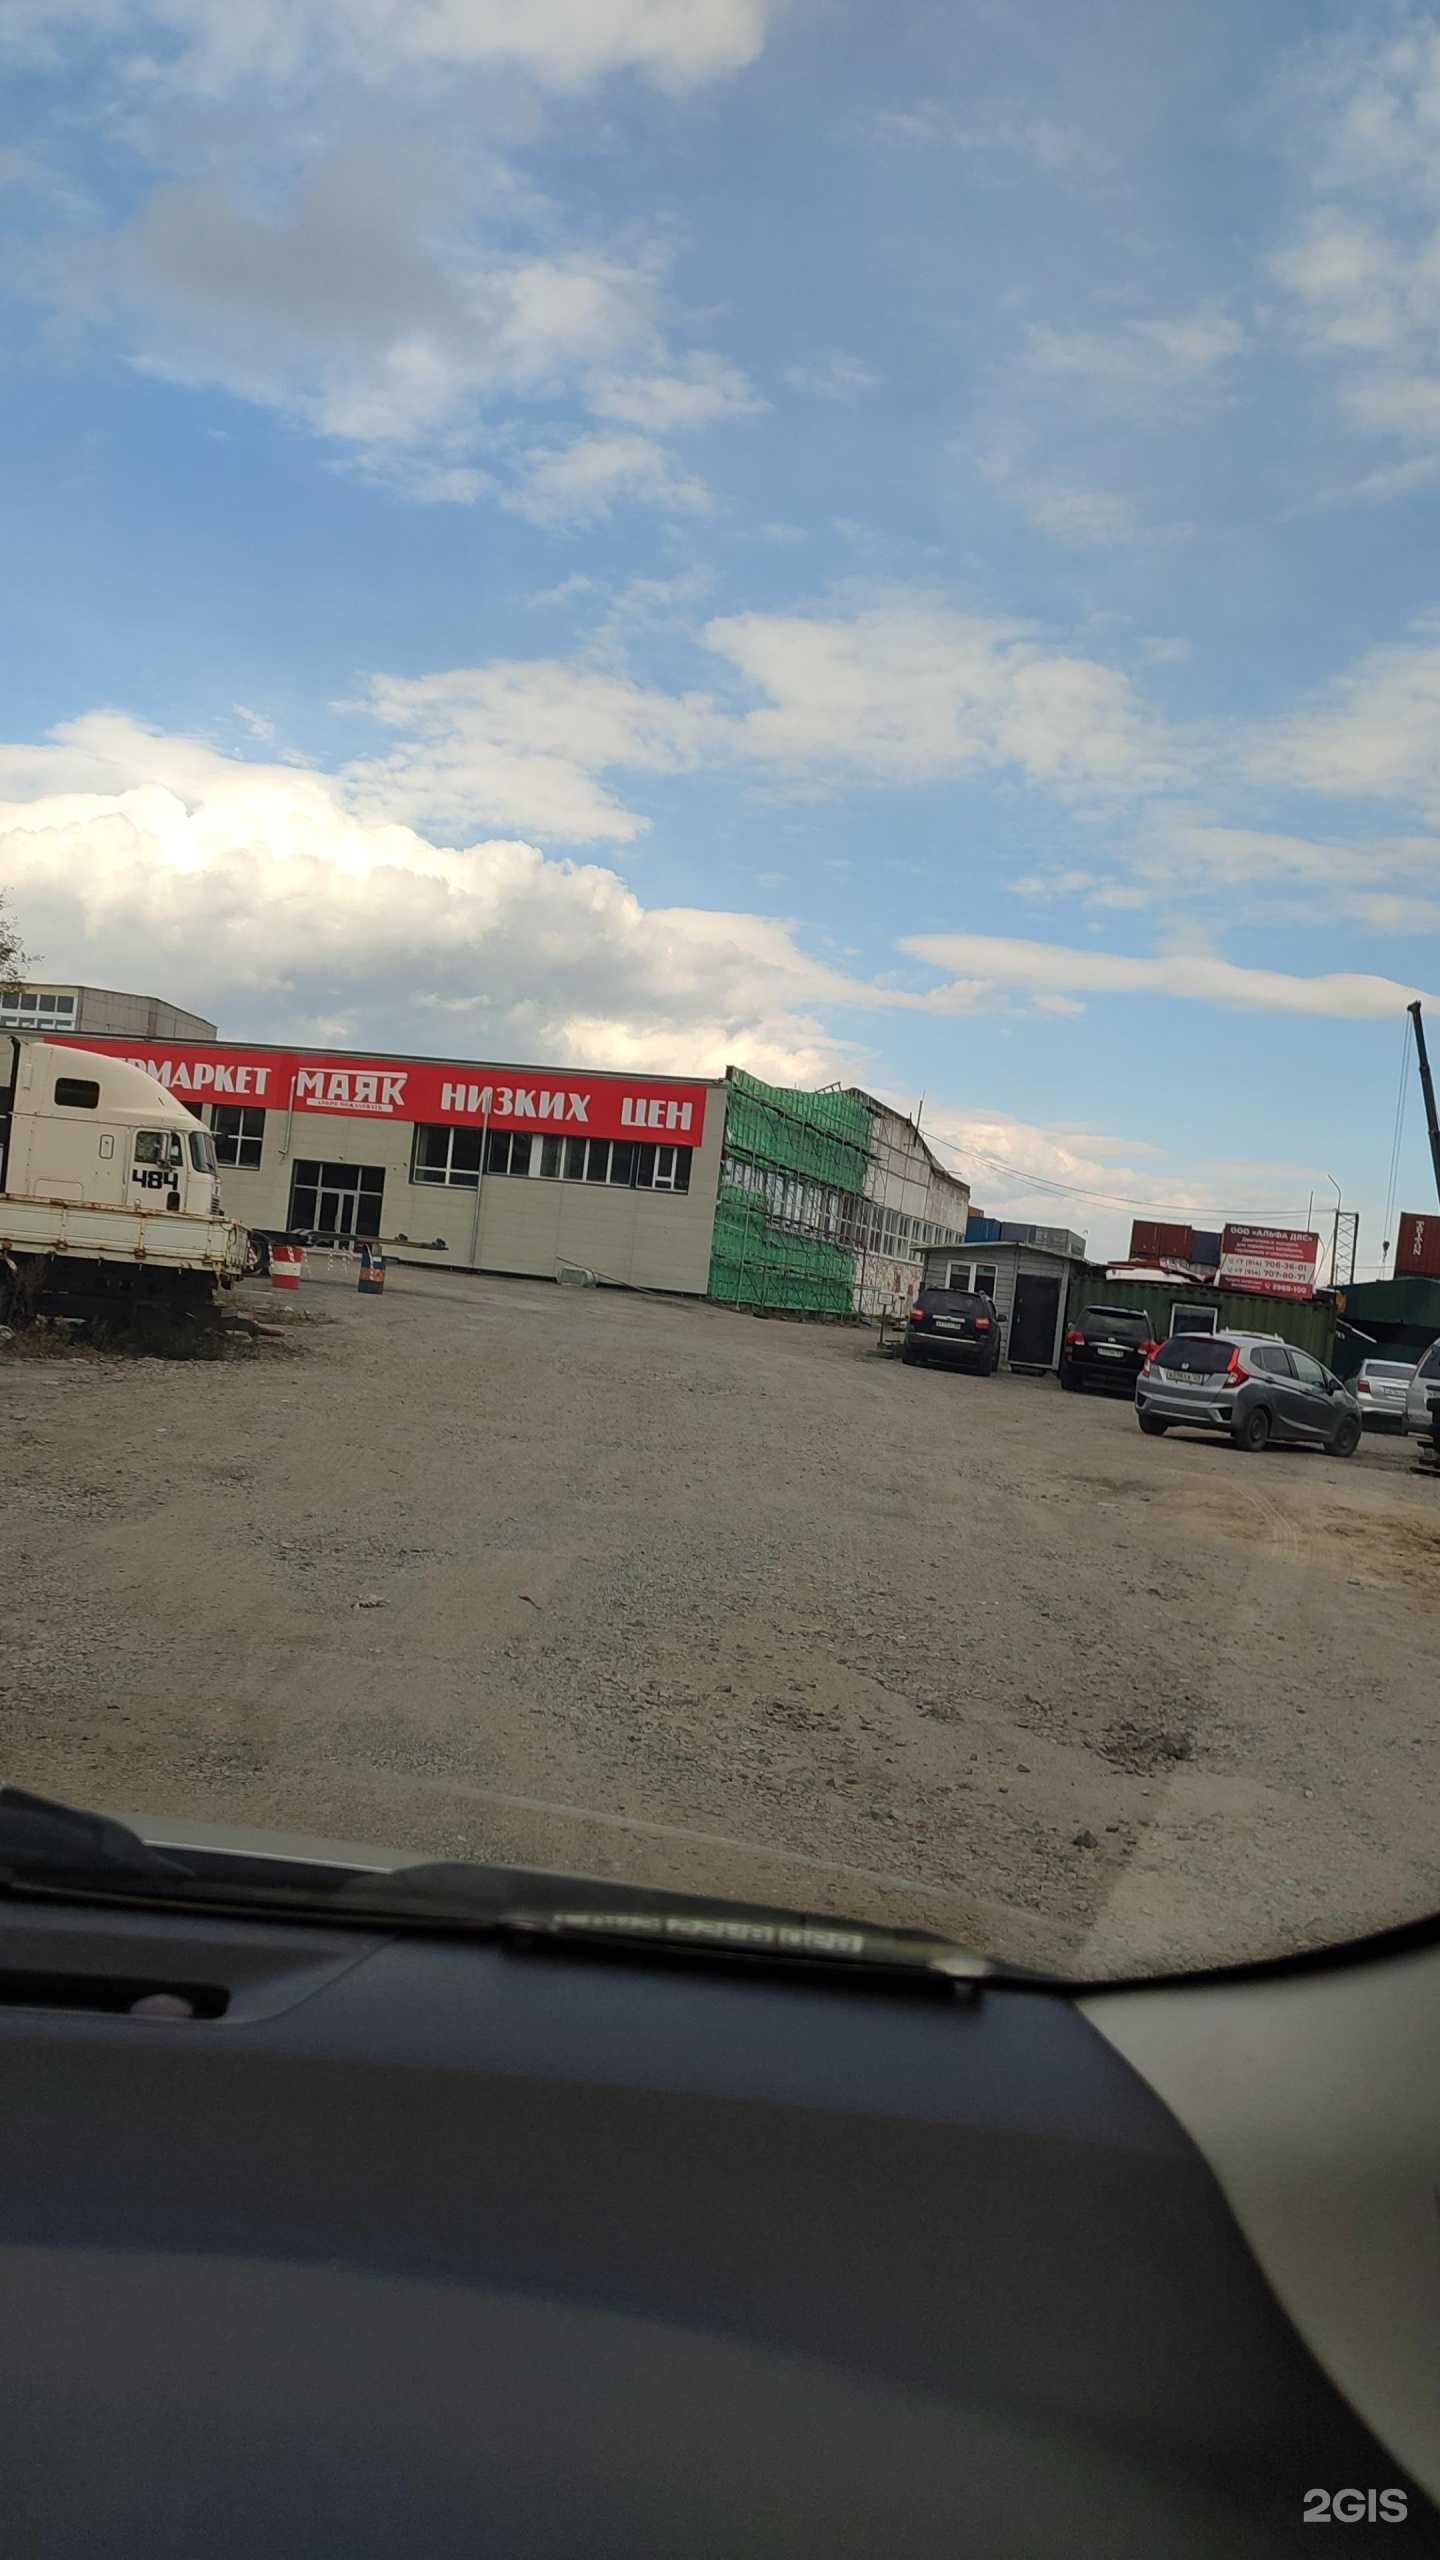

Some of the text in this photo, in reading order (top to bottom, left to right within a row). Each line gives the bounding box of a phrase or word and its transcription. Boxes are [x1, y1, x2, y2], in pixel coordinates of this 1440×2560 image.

[295, 1070, 407, 1106] МАЯК
[441, 1082, 591, 1123] НИЗКИХ
[620, 1097, 693, 1131] ЦЕН
[132, 1169, 178, 1190] 484
[1230, 1226, 1250, 1235] ООО
